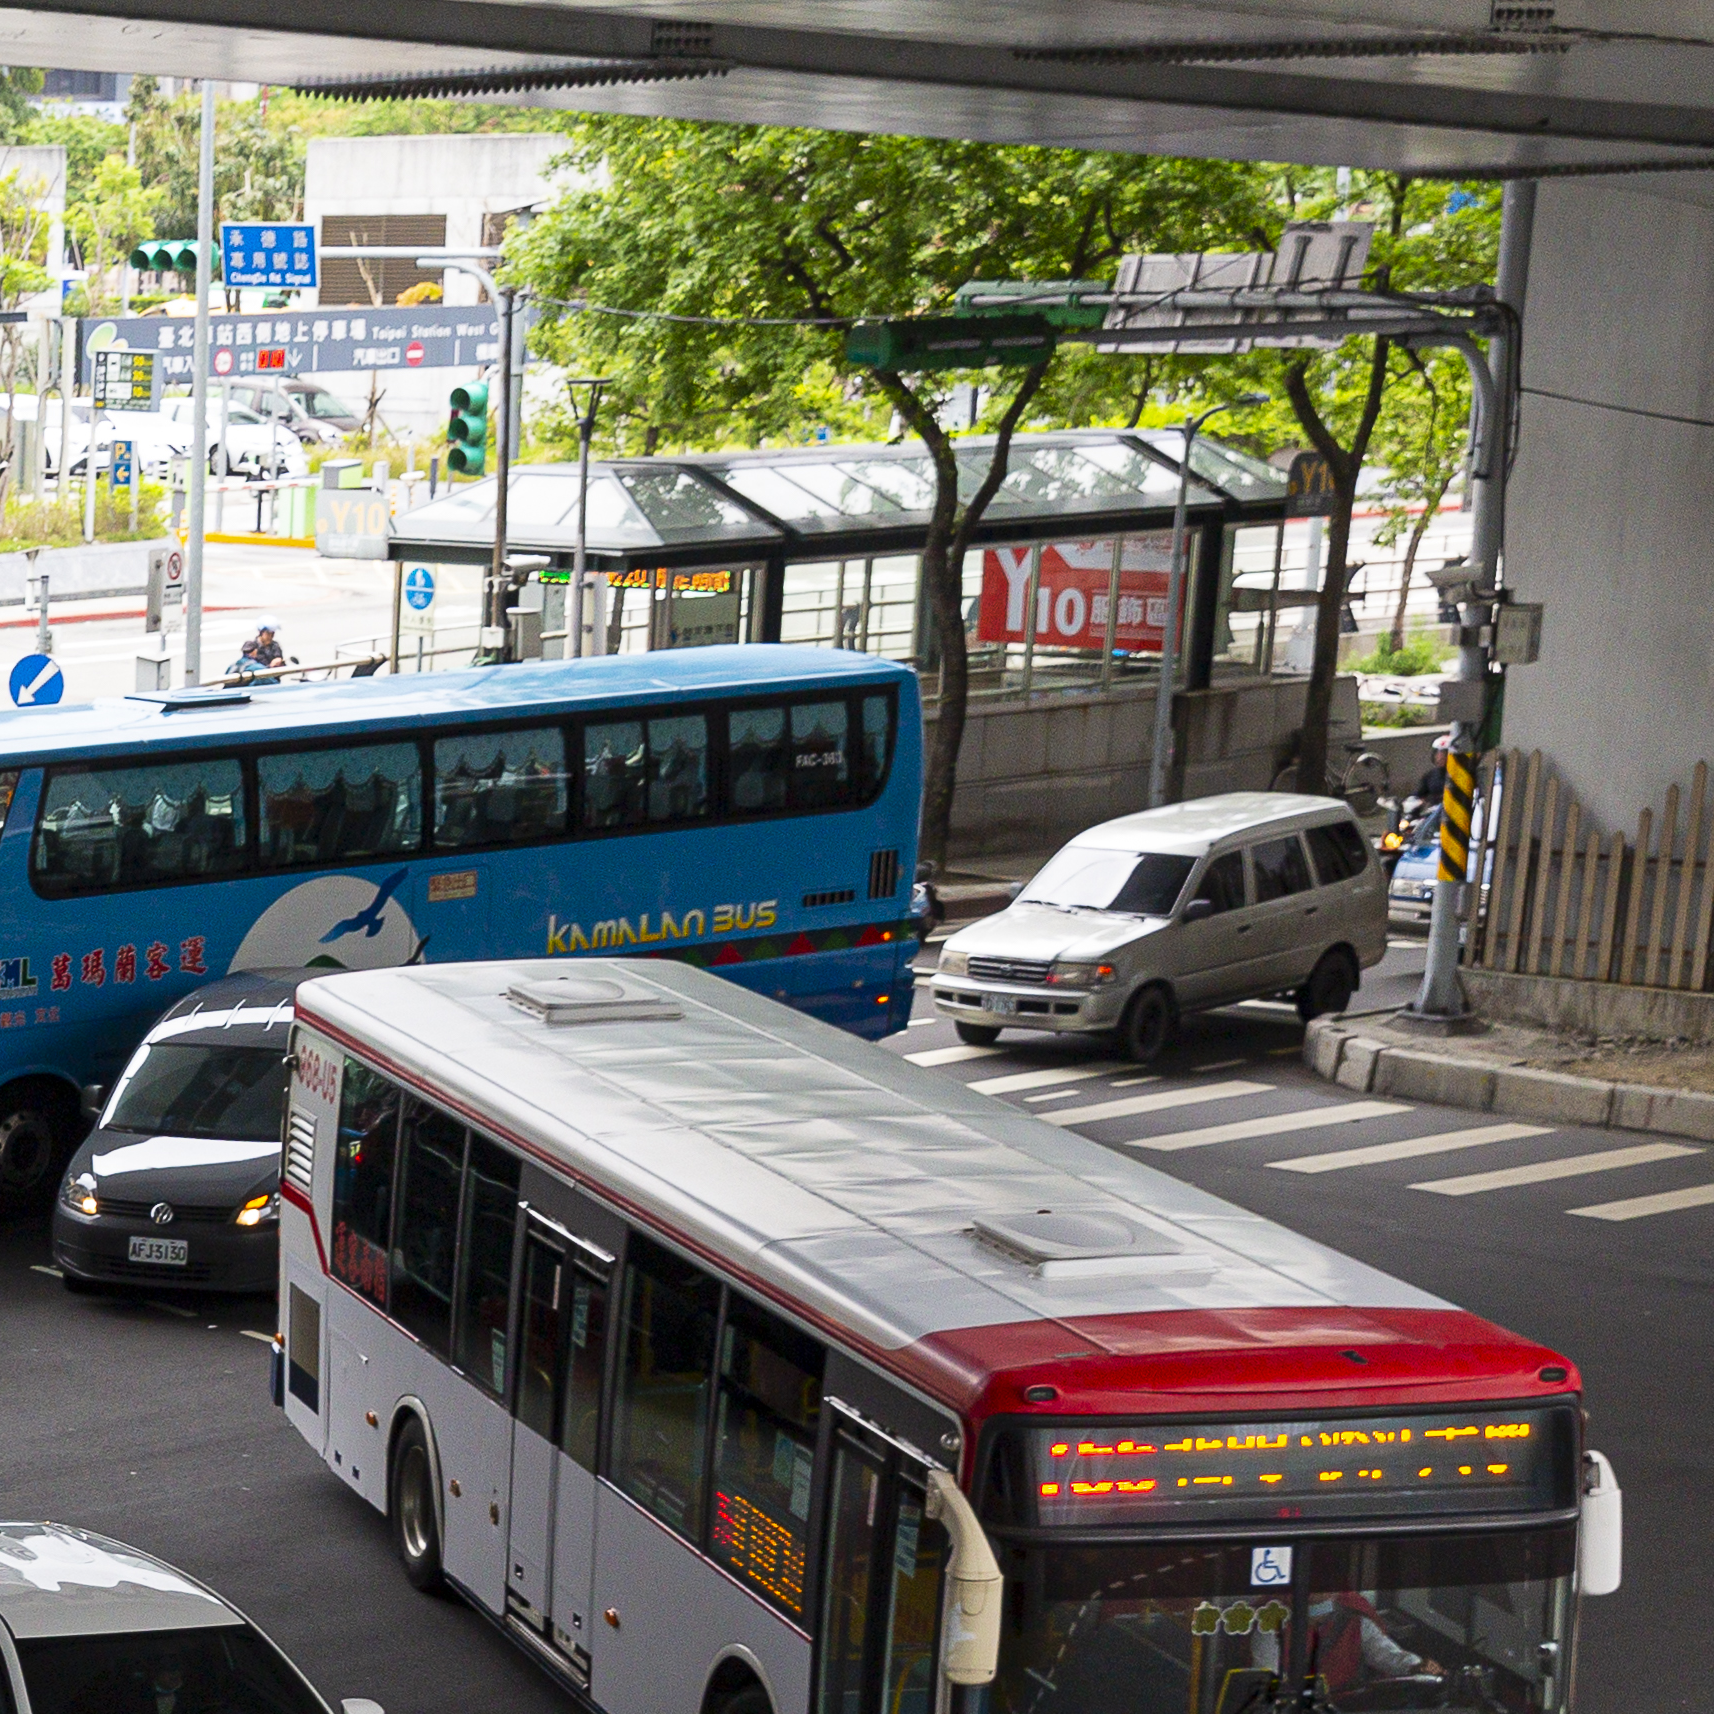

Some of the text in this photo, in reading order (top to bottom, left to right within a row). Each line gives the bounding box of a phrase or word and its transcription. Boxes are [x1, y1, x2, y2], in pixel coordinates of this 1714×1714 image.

[371, 325, 408, 342] Taipei
[411, 323, 452, 339] Station
[455, 321, 486, 337] West
[330, 500, 387, 536] Y10
[548, 898, 778, 955] KAMALAN BUS
[50, 934, 209, 992] 葛瑪蘭客運
